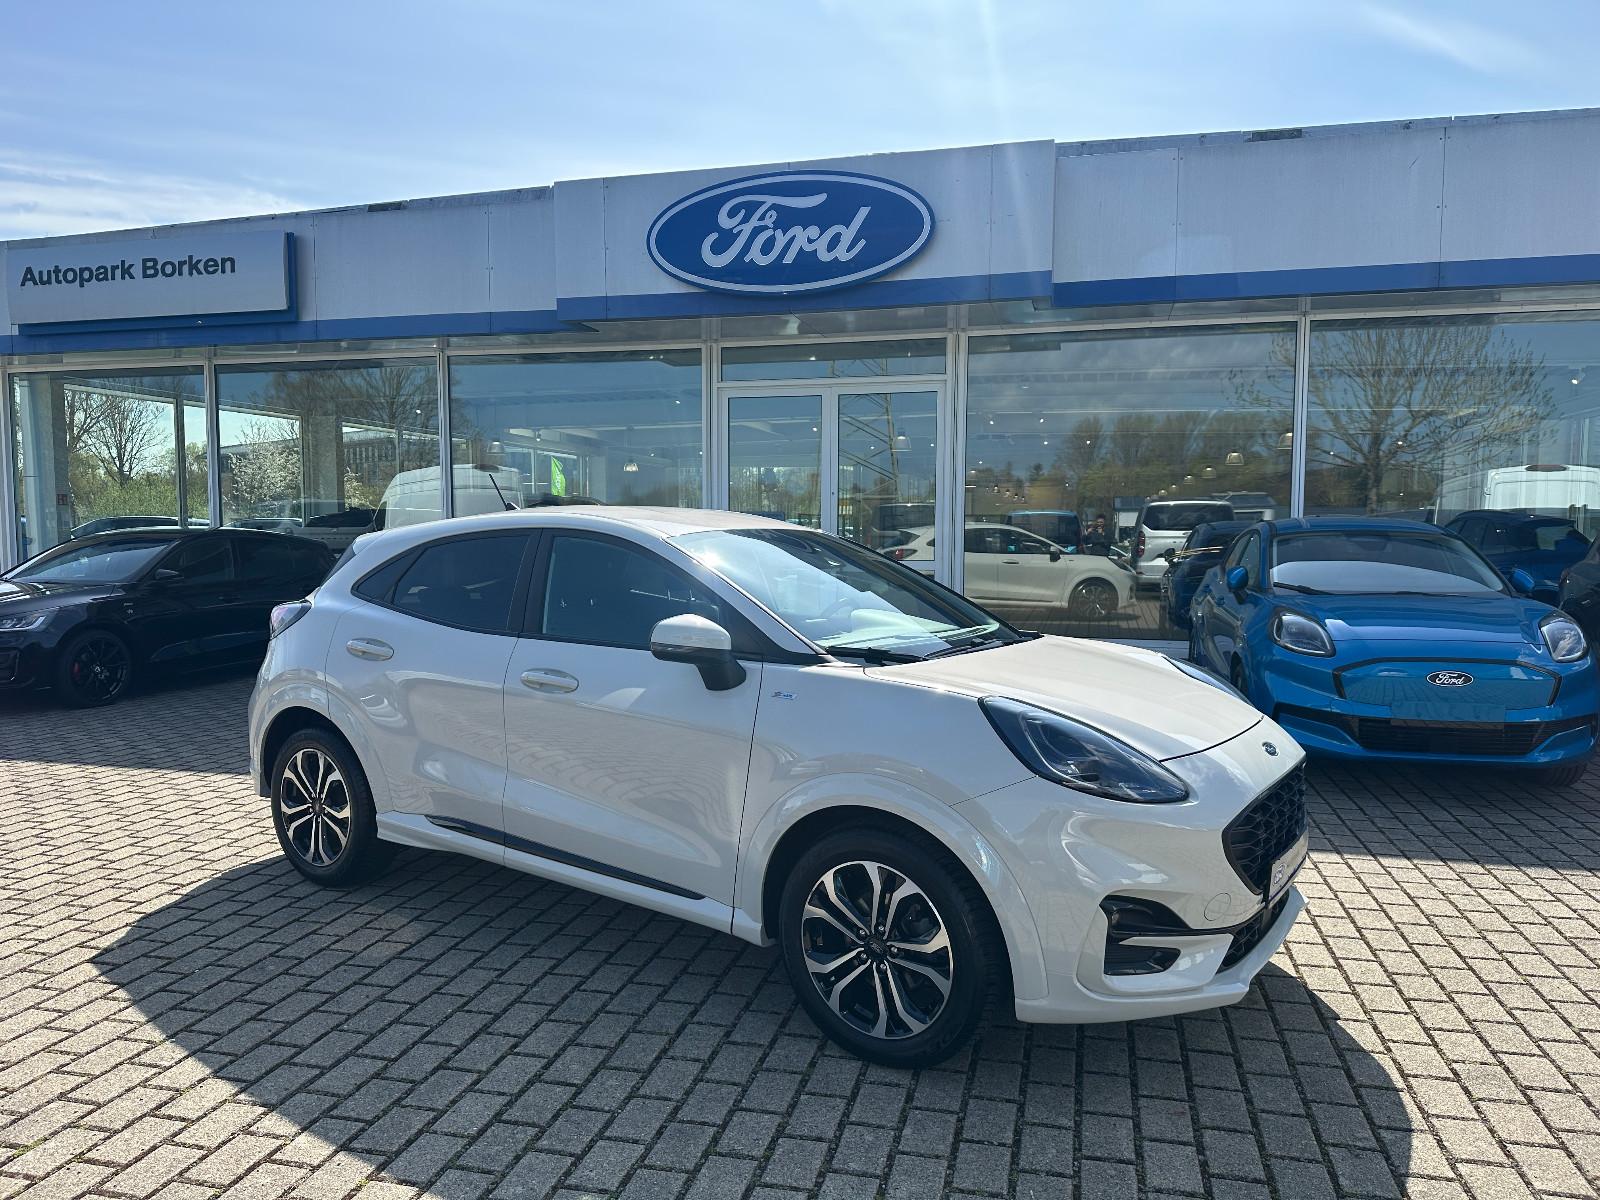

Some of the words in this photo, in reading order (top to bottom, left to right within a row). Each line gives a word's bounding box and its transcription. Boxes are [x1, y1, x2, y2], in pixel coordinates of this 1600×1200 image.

[701, 193, 871, 267] Ford
[20, 259, 135, 288] Autopark
[141, 254, 236, 279] Borken
[1435, 671, 1465, 685] Ford
